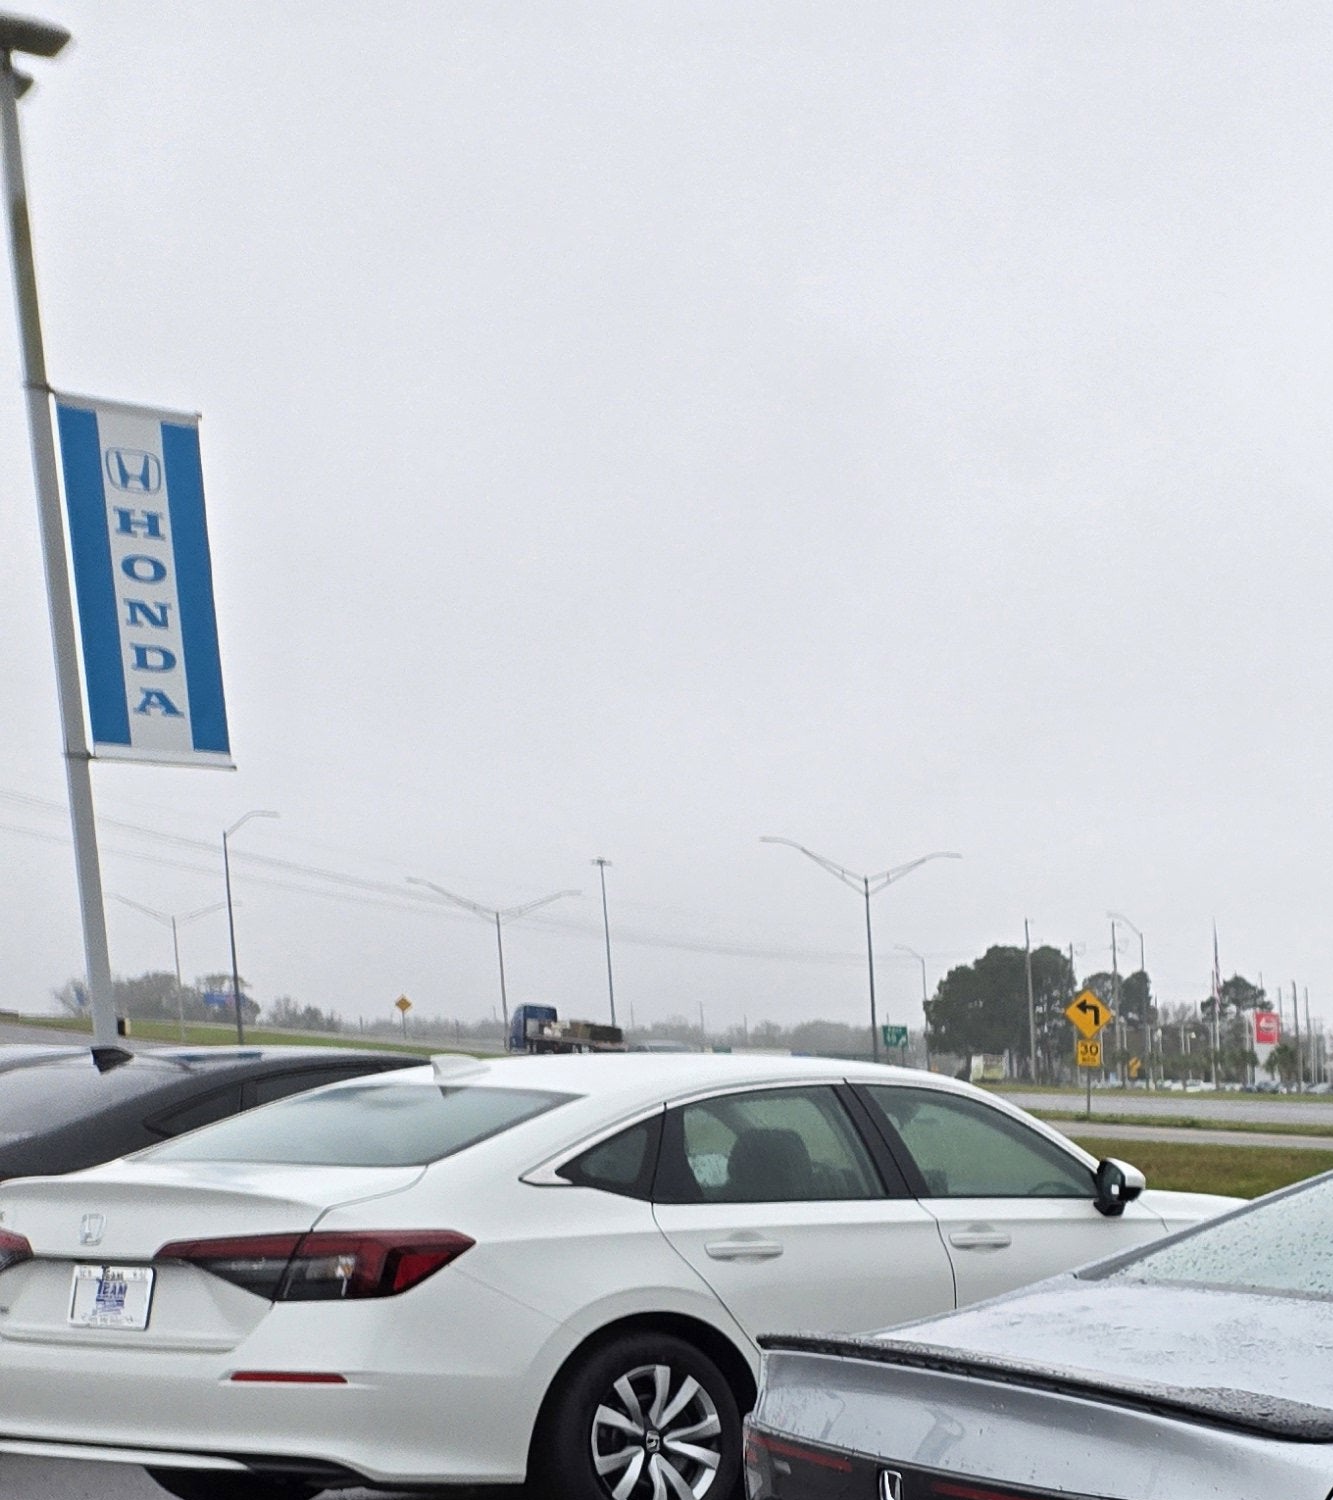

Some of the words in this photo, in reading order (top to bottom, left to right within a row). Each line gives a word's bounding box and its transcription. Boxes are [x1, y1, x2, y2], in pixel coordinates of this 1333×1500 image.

[113, 506, 184, 718] HONDA
[1080, 1043, 1099, 1056] 30
[96, 1277, 127, 1296] TEAM
